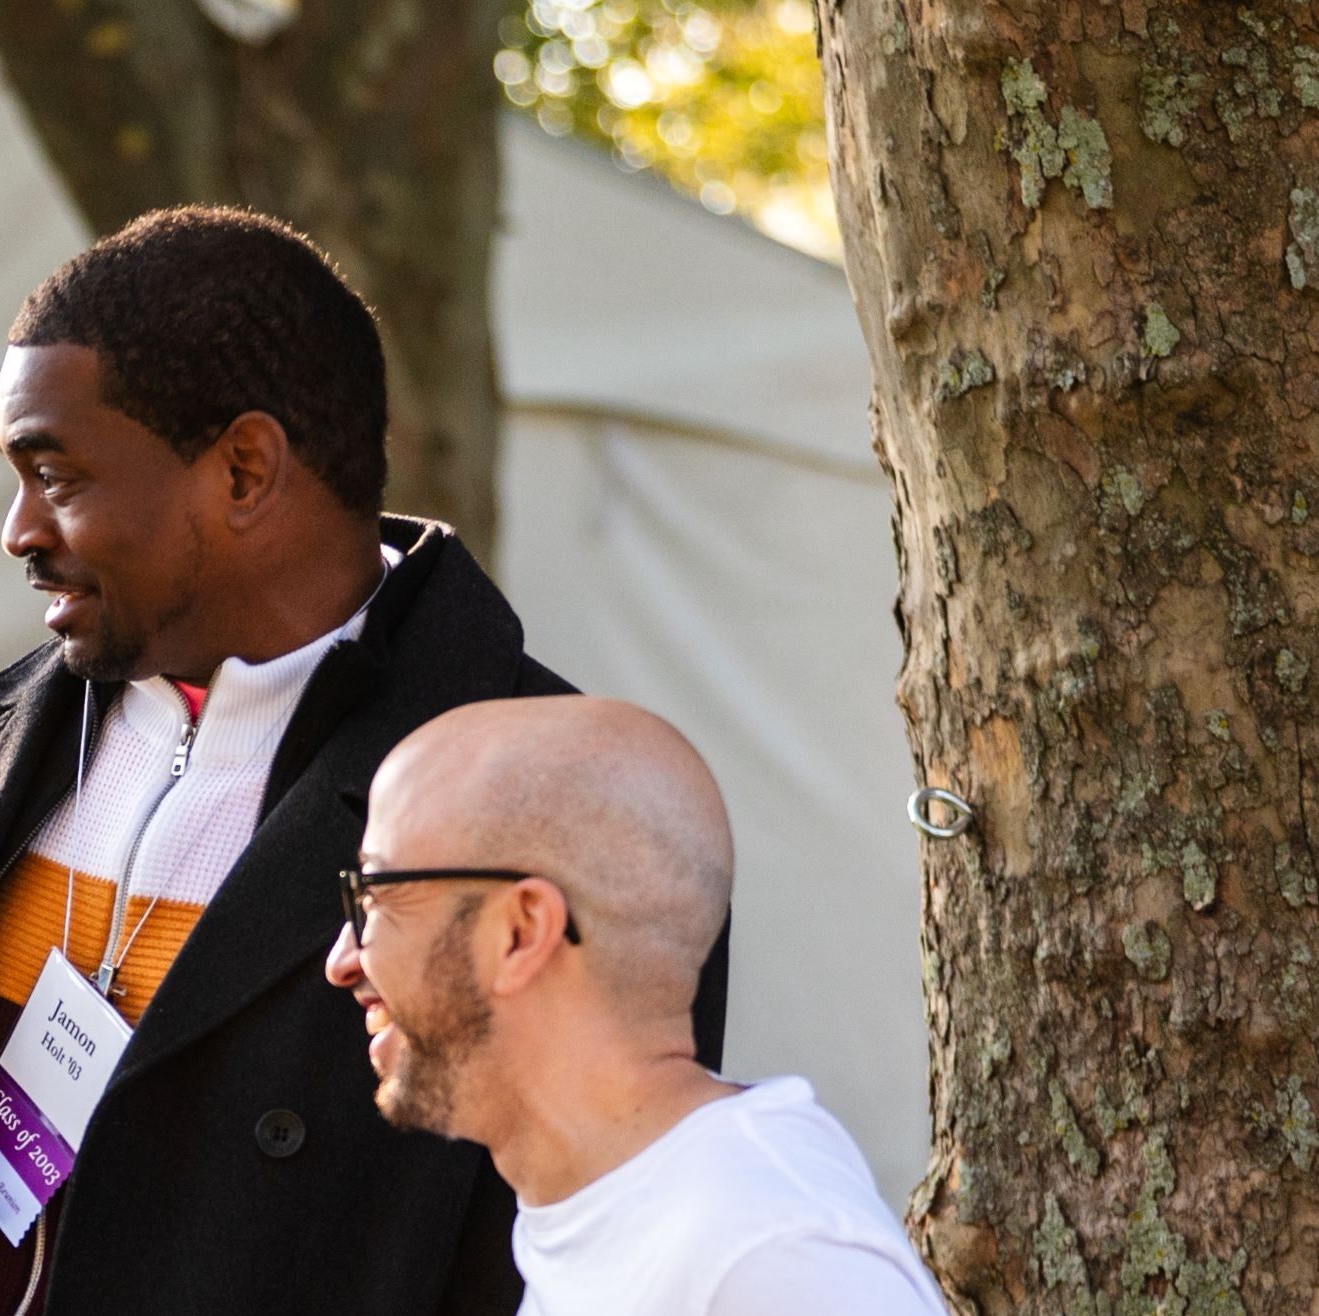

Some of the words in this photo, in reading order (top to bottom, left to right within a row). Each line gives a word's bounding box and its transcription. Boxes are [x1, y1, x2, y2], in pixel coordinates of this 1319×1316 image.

[41, 1031, 65, 1064] Holt
[68, 1056, 82, 1081] '03
[48, 998, 96, 1057] Jamon
[14, 1128, 40, 1151] of
[28, 1146, 61, 1186] 2003
